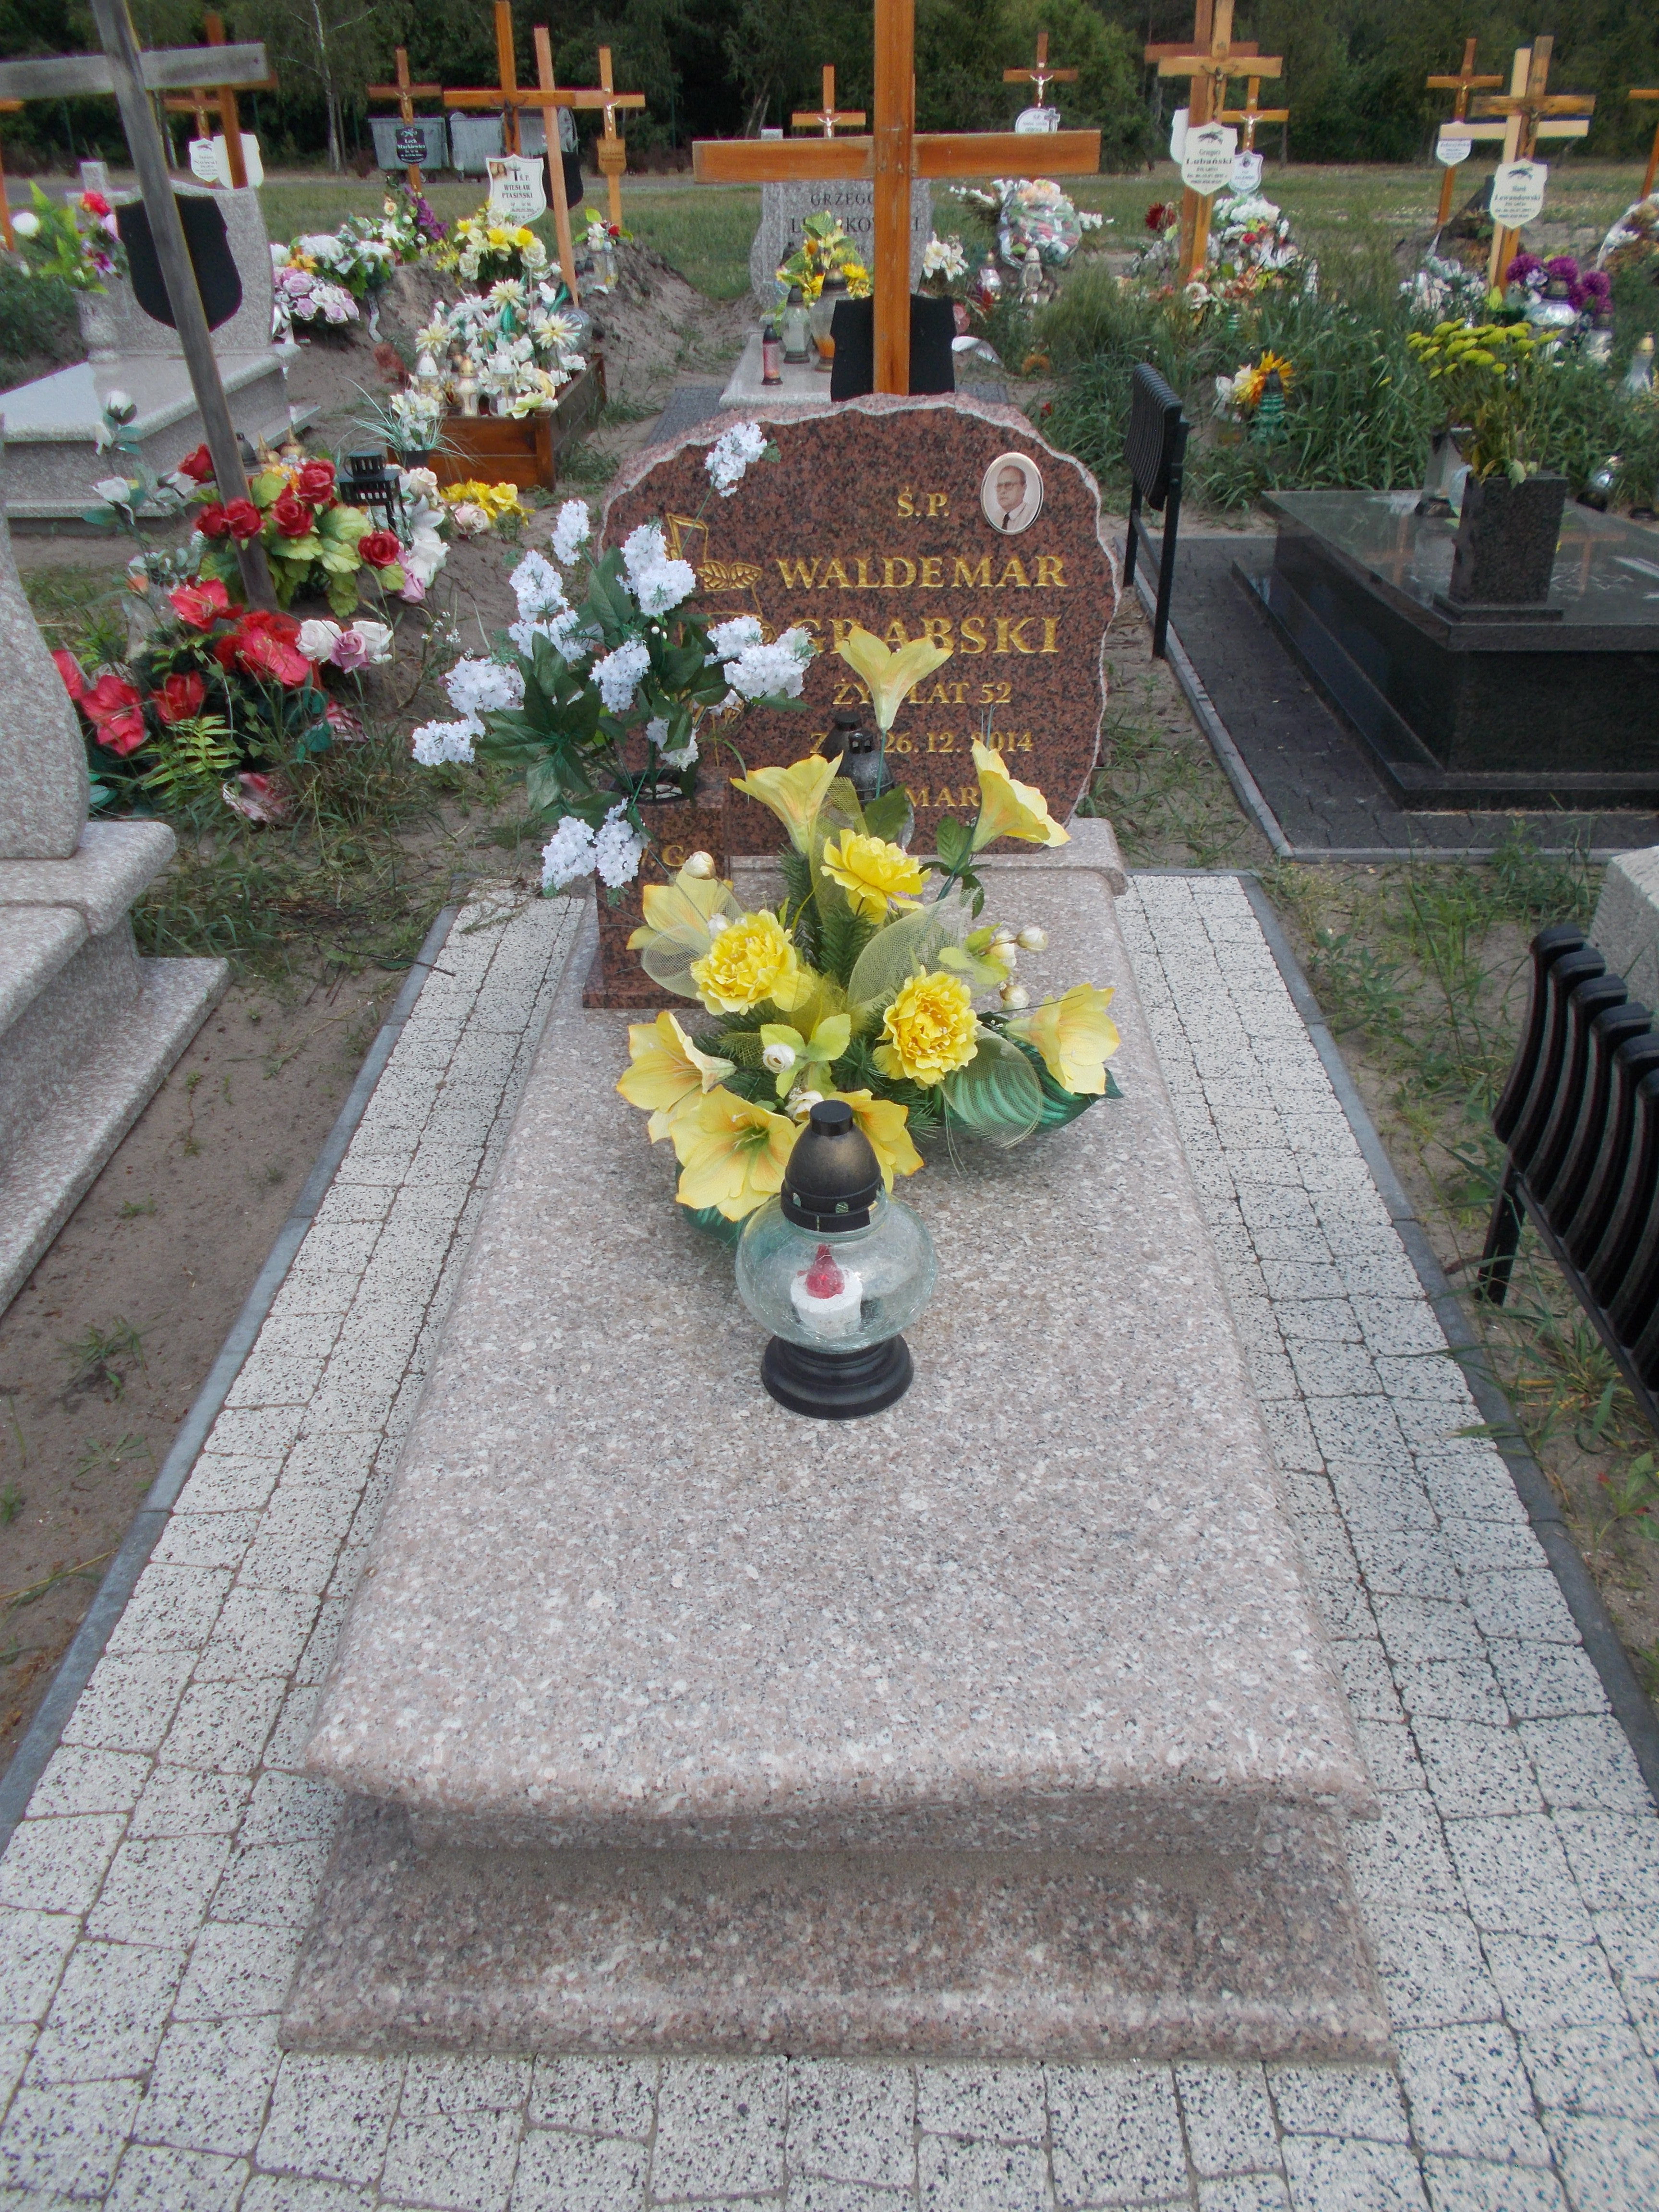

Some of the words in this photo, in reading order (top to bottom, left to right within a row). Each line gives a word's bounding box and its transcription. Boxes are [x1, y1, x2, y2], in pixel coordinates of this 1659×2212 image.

[810, 192, 874, 205] GRZEG
[775, 557, 1069, 589] WALDEMAR
[979, 682, 1012, 704] 52
